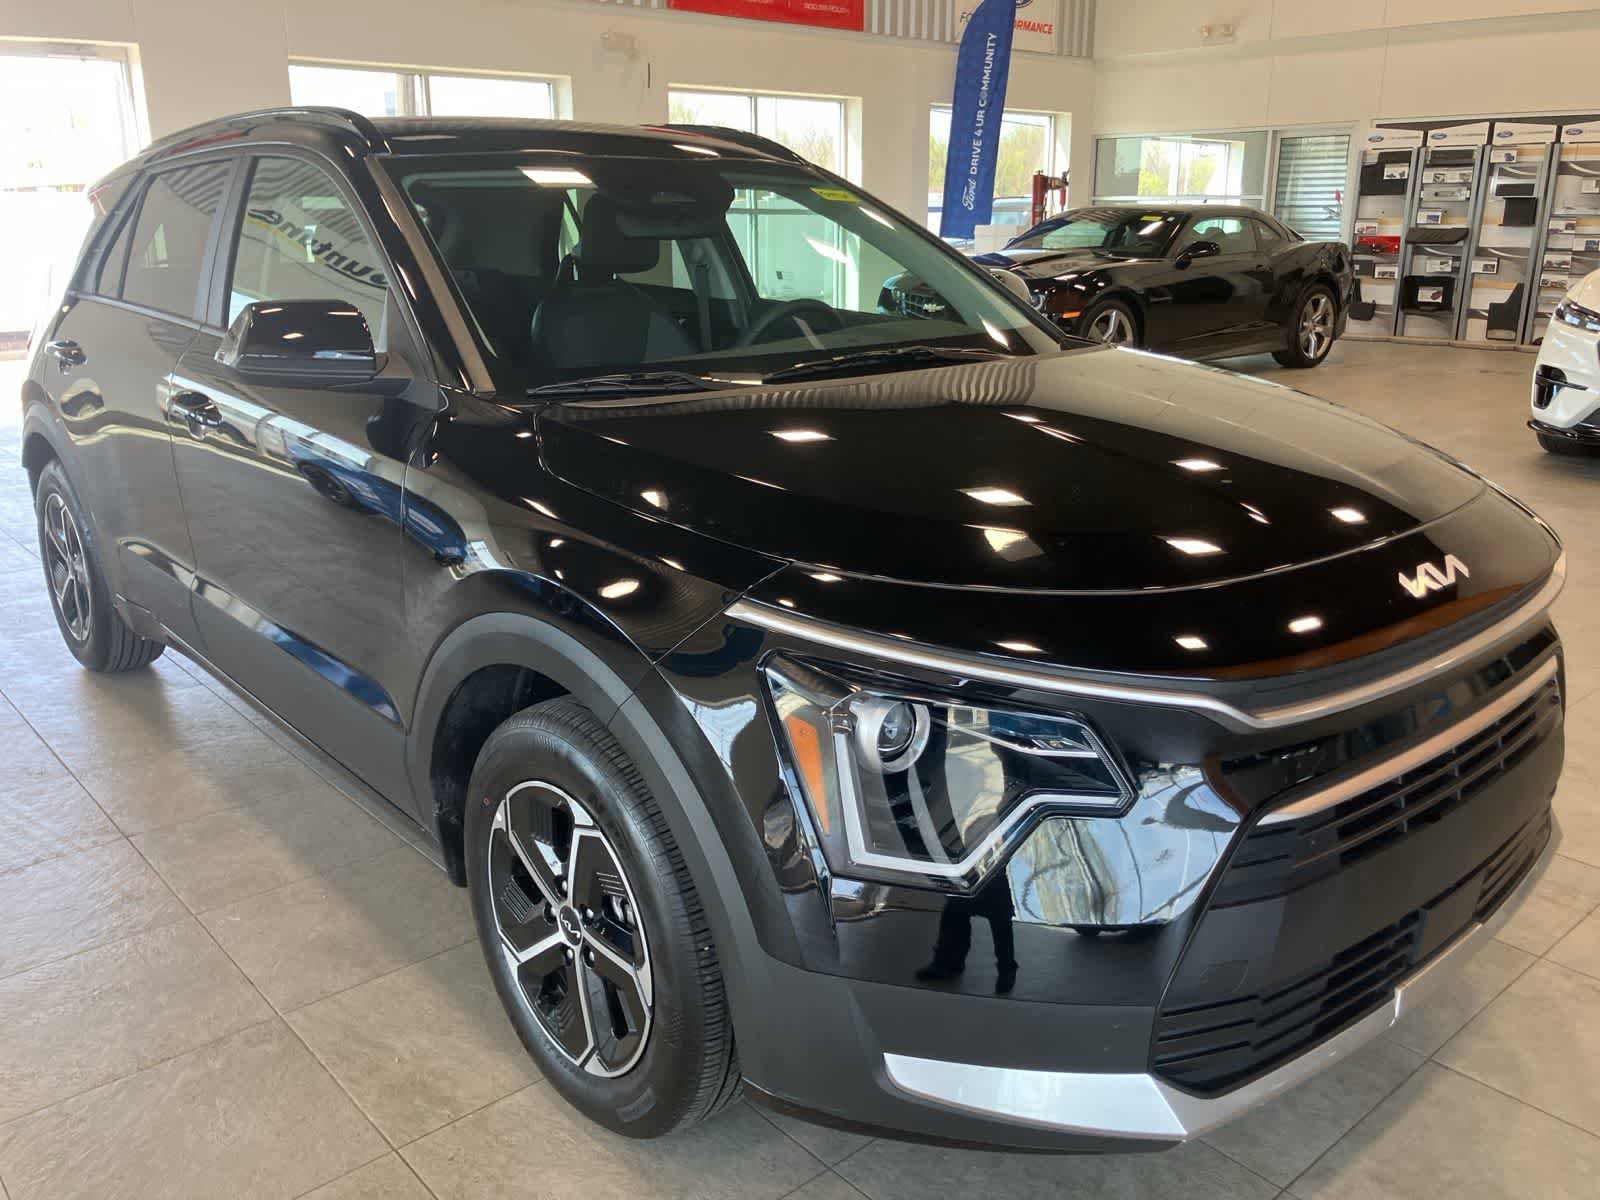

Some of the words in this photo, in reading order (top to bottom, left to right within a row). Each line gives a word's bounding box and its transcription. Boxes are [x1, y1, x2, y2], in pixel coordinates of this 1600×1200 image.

[978, 32, 997, 107] COMMUNITY
[974, 129, 983, 137] 4
[976, 110, 985, 127] UR
[970, 139, 983, 175] DRIVE
[962, 178, 977, 210] Ford
